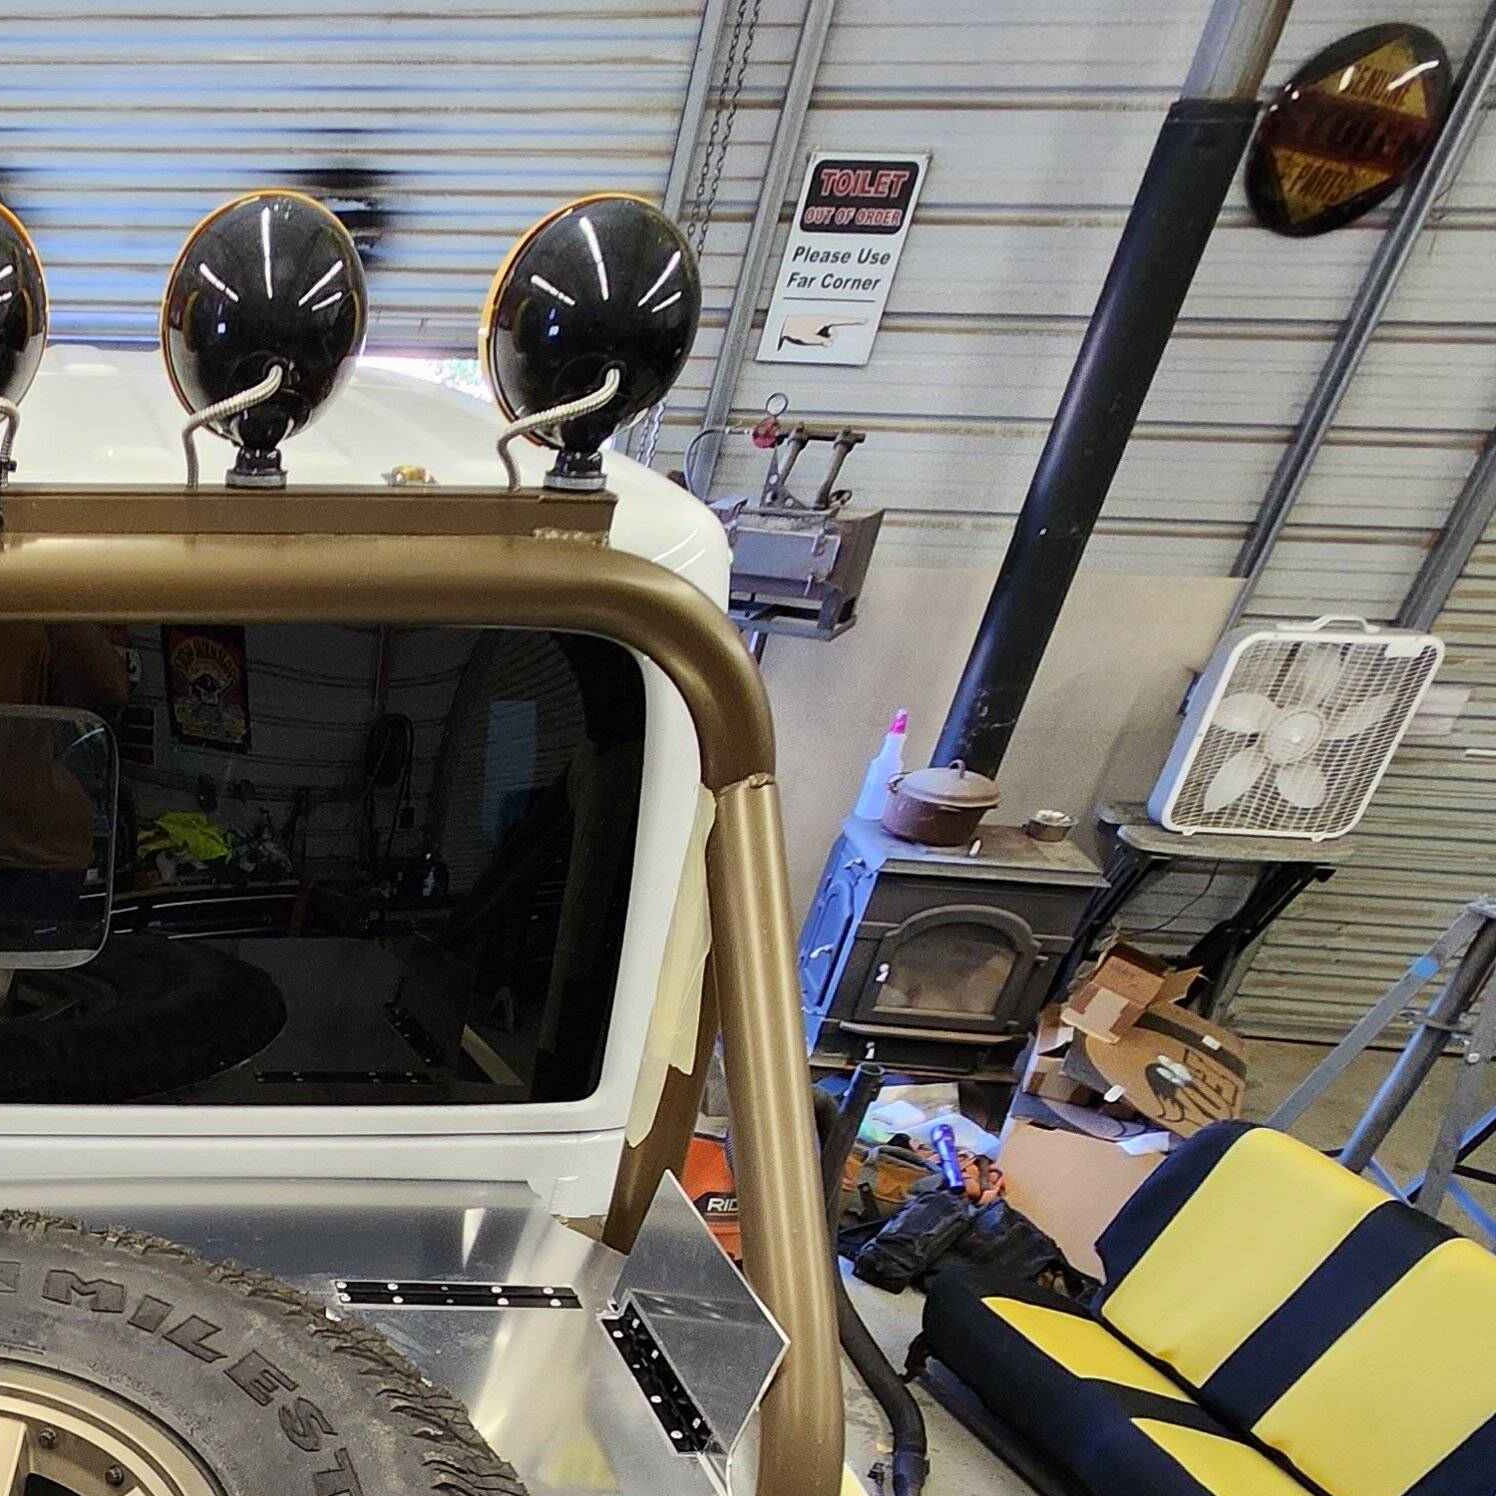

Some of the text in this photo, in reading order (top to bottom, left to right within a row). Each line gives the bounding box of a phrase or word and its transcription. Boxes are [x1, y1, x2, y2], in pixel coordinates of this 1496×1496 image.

[820, 169, 910, 198] TOILET
[804, 206, 904, 227] OUT OF ORDER
[792, 246, 892, 265] Please Use
[786, 272, 882, 291] Far Corner
